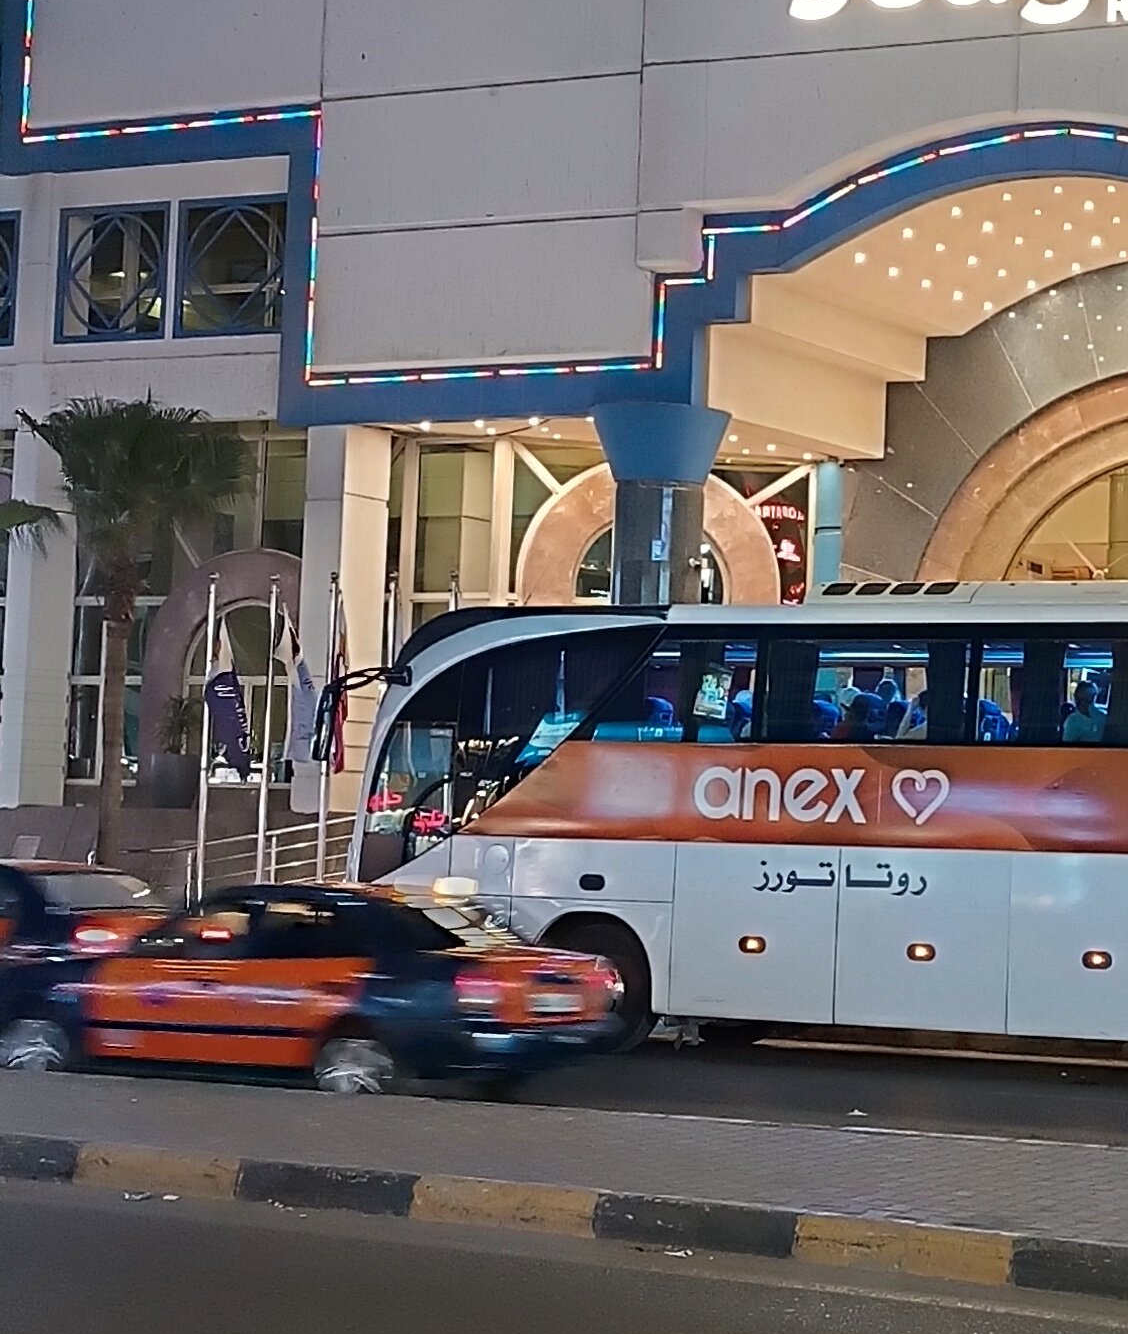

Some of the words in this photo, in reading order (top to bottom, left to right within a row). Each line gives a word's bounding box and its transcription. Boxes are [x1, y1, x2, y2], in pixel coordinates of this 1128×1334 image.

[694, 766, 866, 824] anex
[753, 860, 836, 893] تورز
[846, 863, 928, 896] روتا
